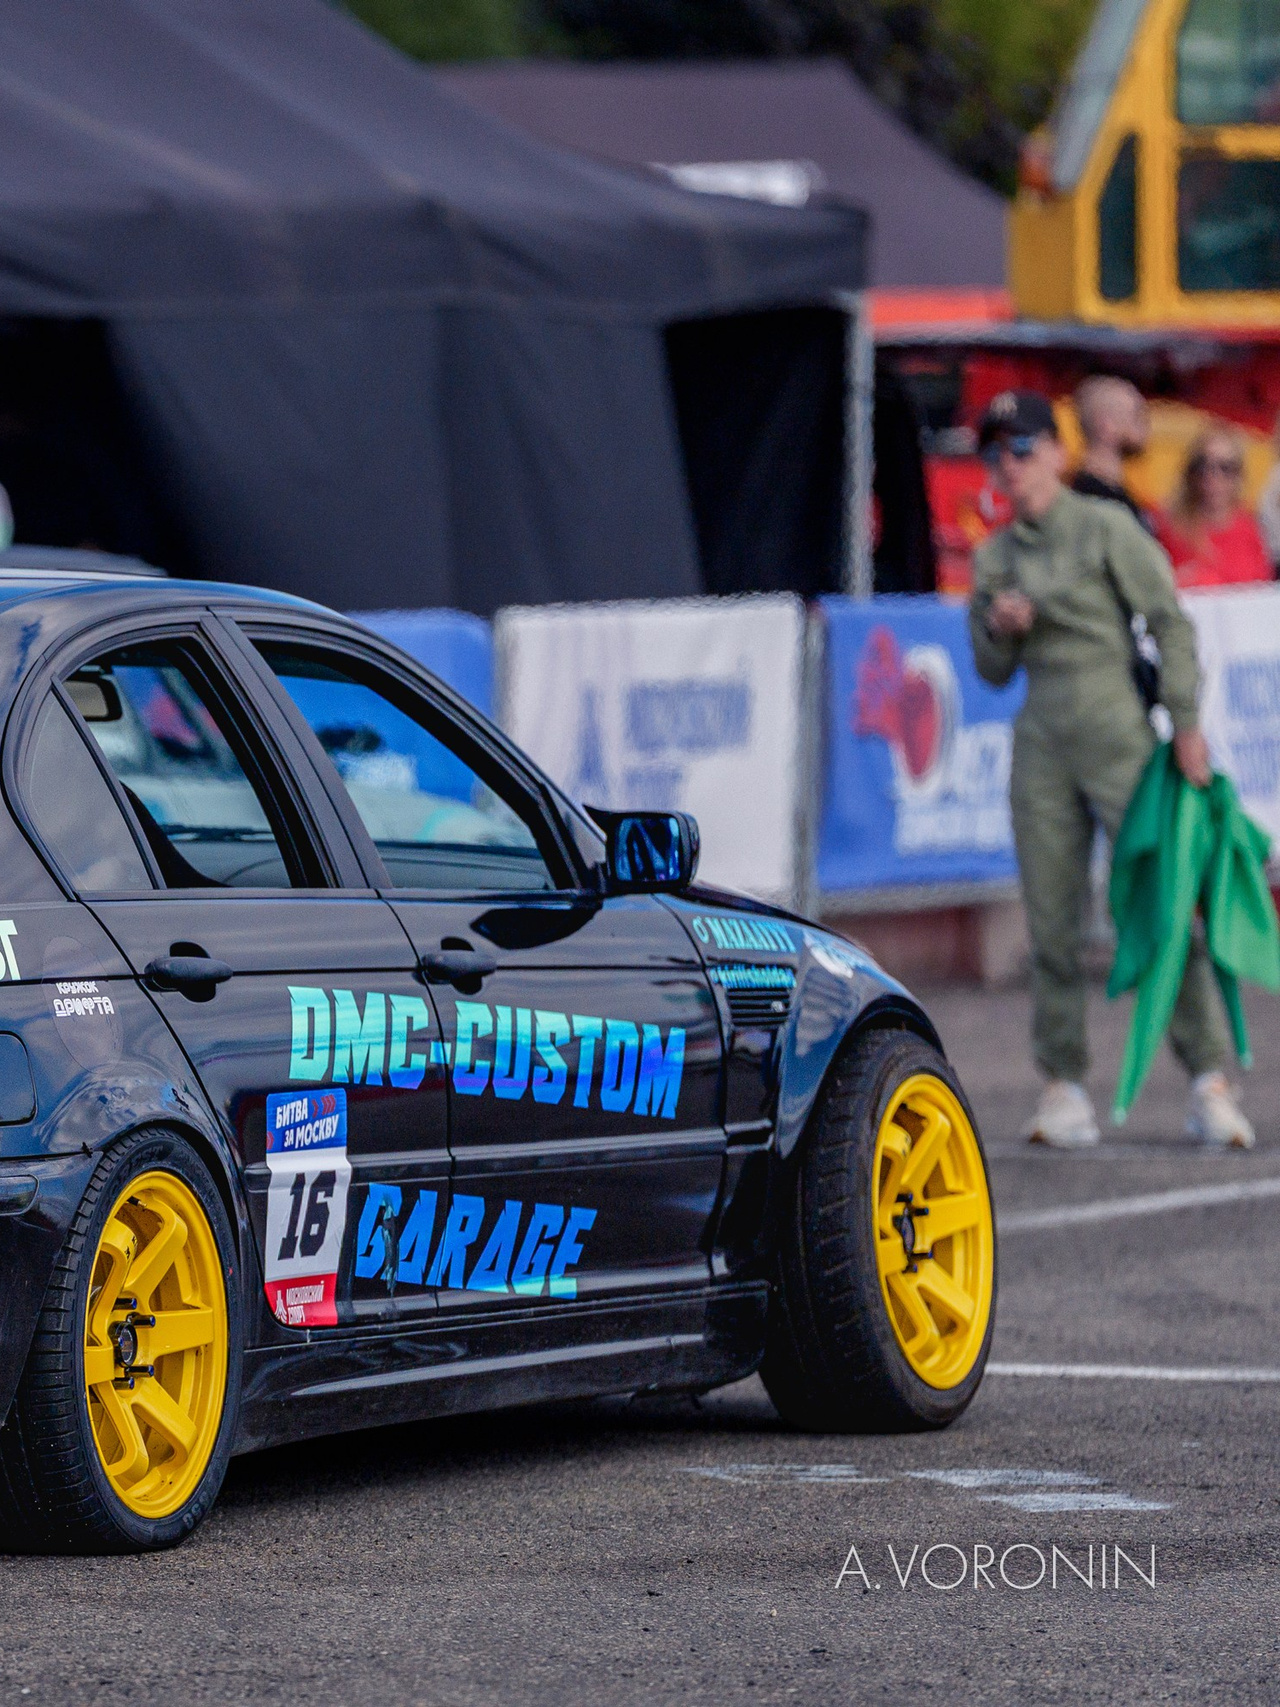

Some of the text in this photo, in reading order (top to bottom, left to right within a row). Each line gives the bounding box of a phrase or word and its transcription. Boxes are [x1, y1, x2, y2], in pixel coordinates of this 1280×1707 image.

[53, 996, 115, 1017] ДРИФТА
[275, 1097, 308, 1130] БИТВА
[283, 1113, 340, 1149] ЗА МОСКВУ
[277, 1169, 337, 1261] 16
[355, 1181, 598, 1300] GARAGE
